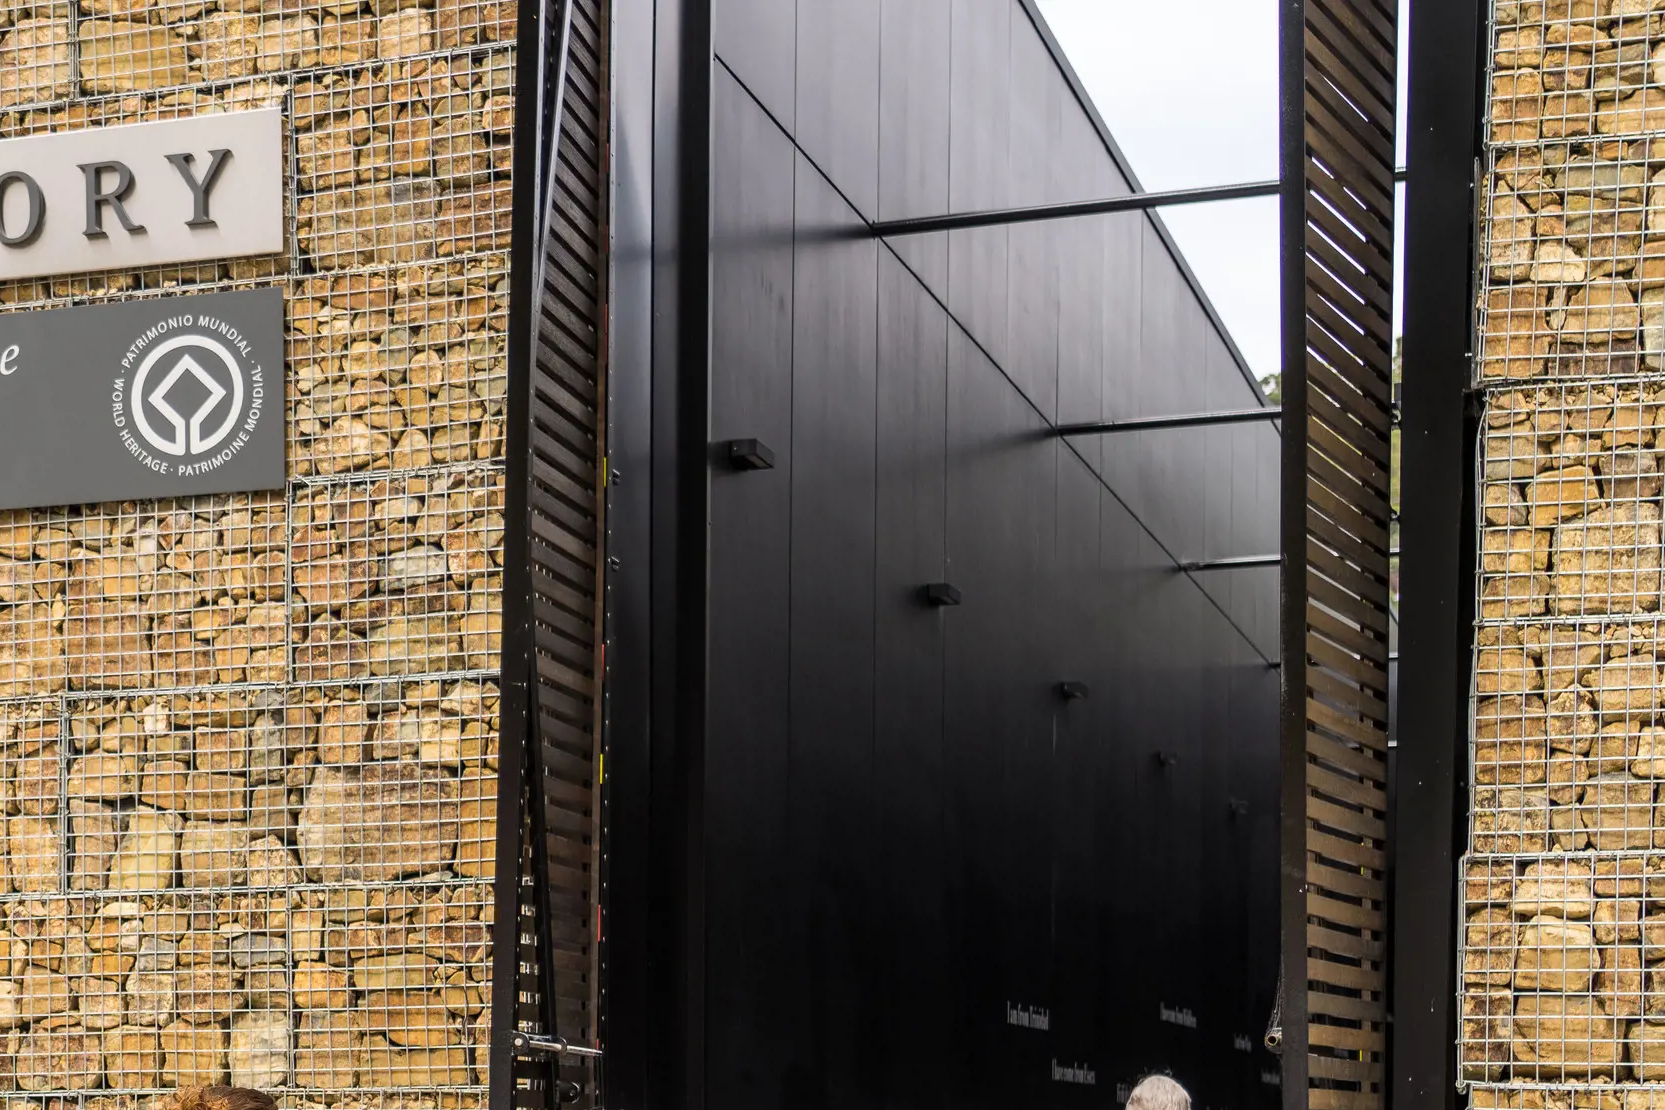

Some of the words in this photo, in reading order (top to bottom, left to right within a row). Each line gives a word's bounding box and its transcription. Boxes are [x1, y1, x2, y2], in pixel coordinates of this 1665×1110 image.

[121, 314, 194, 370] PATRIMONIO
[197, 315, 252, 358] MUNDIAL
[111, 377, 126, 428] WORLD
[119, 428, 169, 475] HERITAGE
[178, 431, 250, 477] PATRIMOINE
[248, 364, 264, 433] MONDIAL
